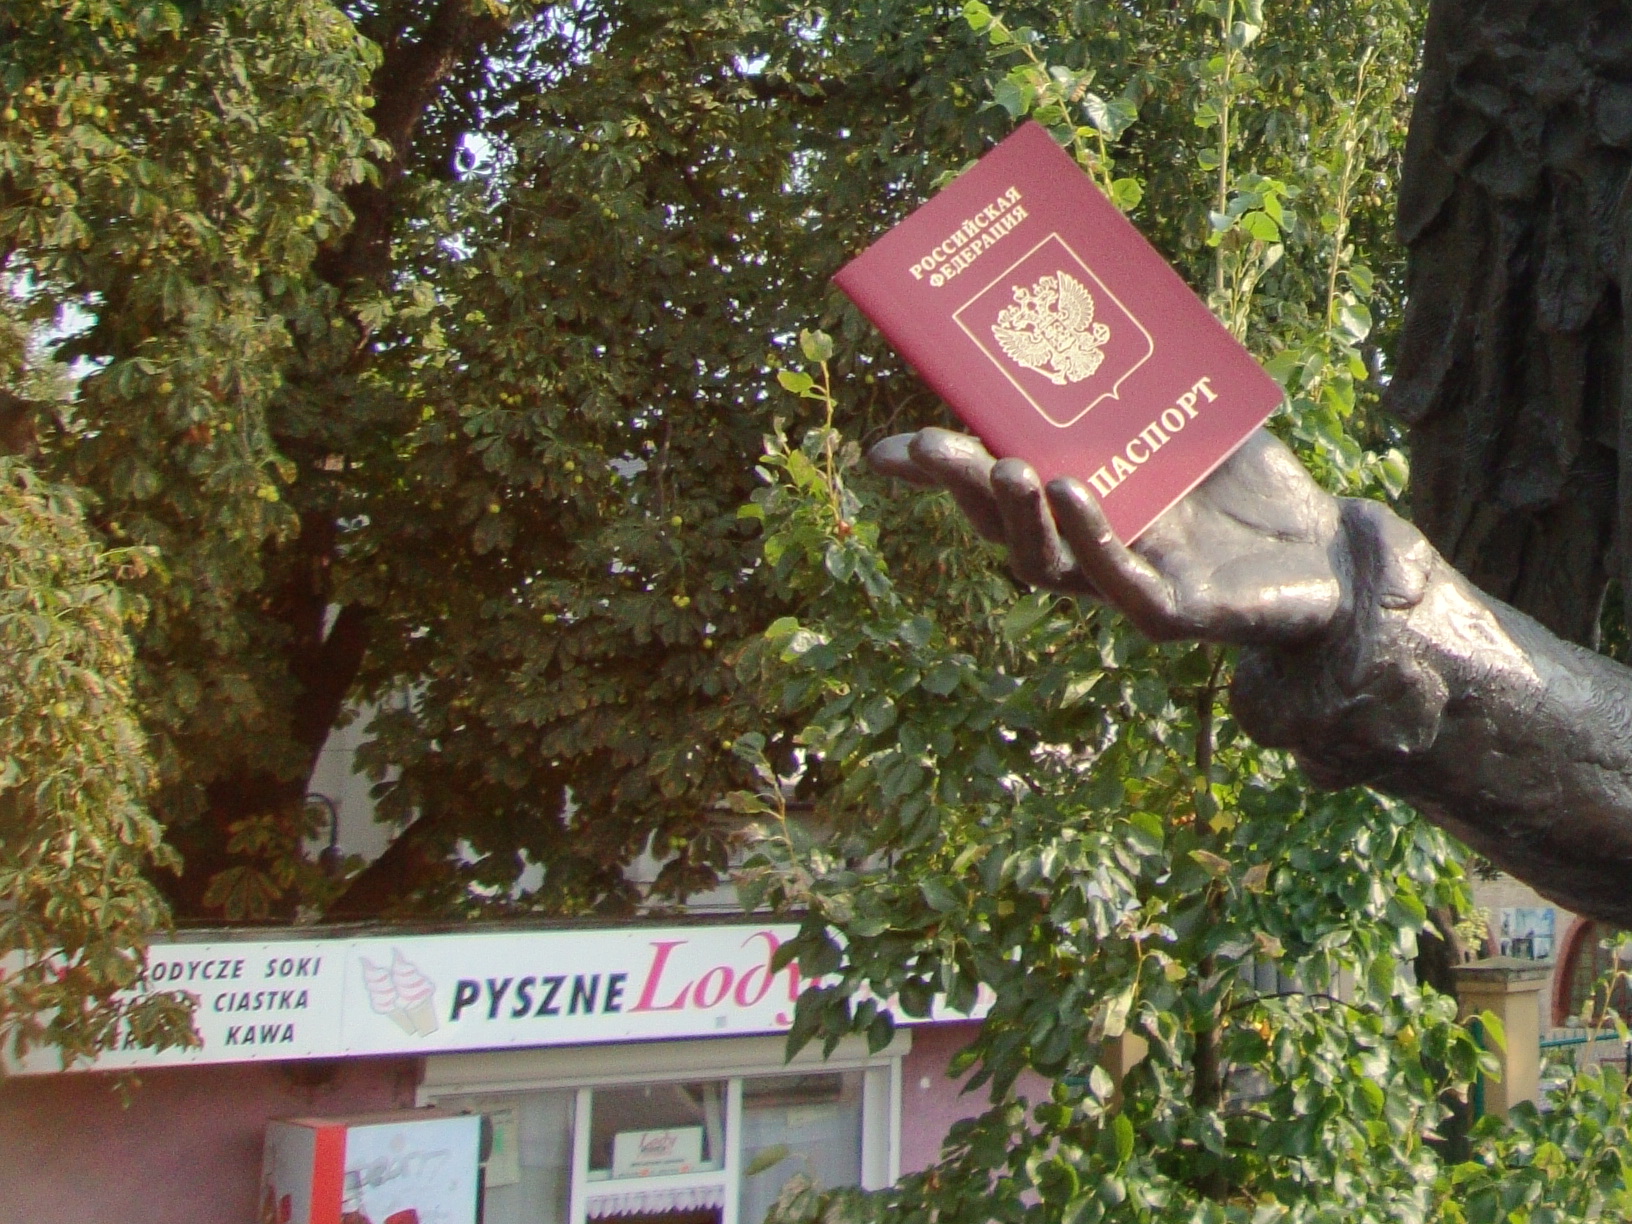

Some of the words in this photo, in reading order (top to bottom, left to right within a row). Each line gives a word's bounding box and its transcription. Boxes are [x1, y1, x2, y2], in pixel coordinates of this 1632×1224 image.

[909, 186, 1022, 280] РОССИЙСКАЯ
[929, 204, 1029, 287] ФЕДЕРАЦИЯ
[1087, 376, 1218, 498] ПАСПОРТ
[139, 959, 245, 982] ODYCZE
[264, 956, 322, 978] SOKI
[214, 989, 309, 1013] CIASTKA
[449, 972, 628, 1022] PYSZNE
[225, 1023, 295, 1046] KAWA
